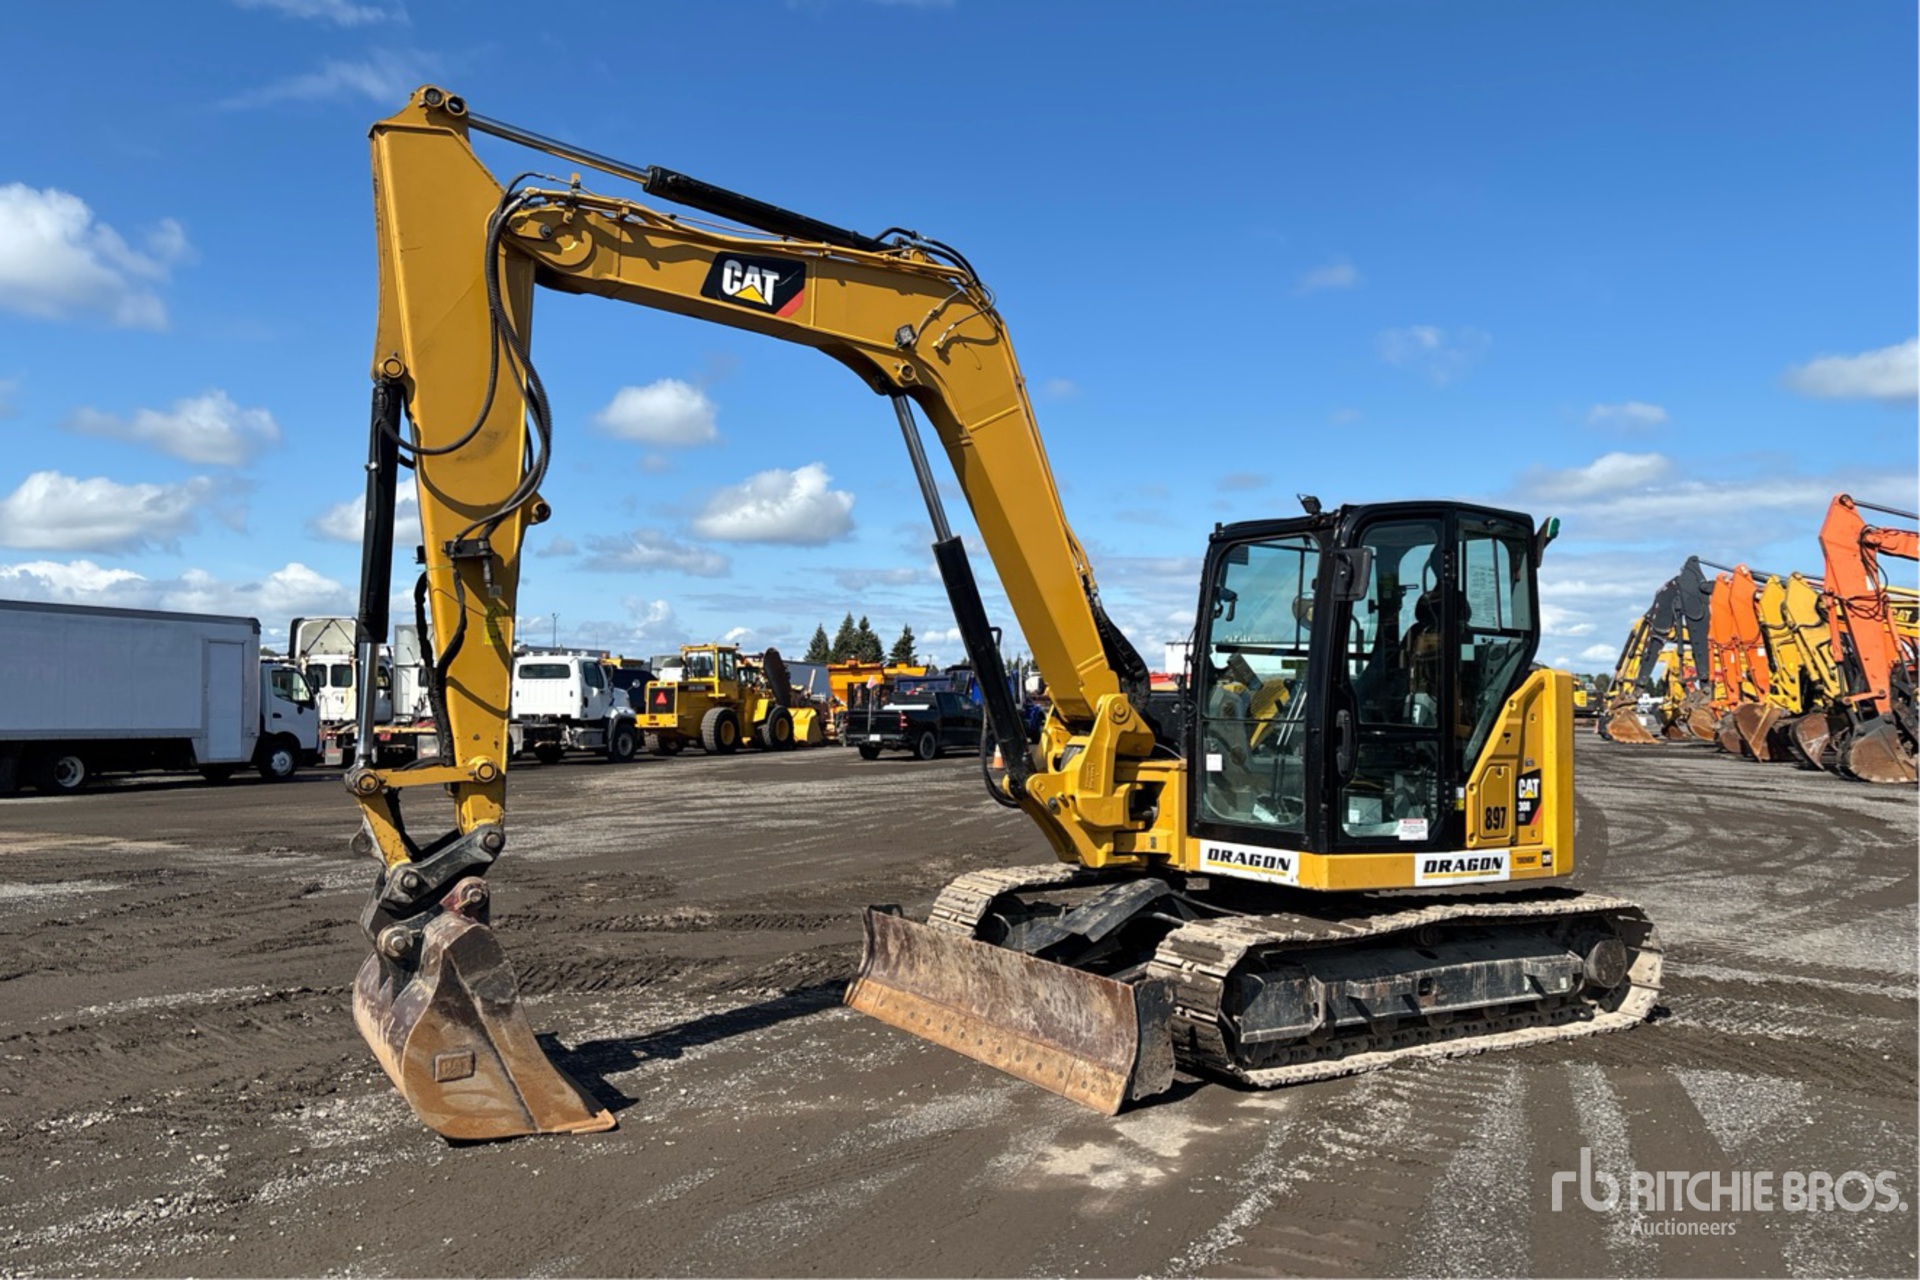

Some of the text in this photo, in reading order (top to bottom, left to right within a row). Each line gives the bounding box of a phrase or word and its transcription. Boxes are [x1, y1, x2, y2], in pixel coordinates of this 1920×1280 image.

[722, 259, 780, 306] CAT
[1518, 778, 1540, 799] CAT
[1485, 806, 1507, 831] 897
[1207, 848, 1291, 872] DRAGON
[1423, 856, 1504, 873] DRAGON
